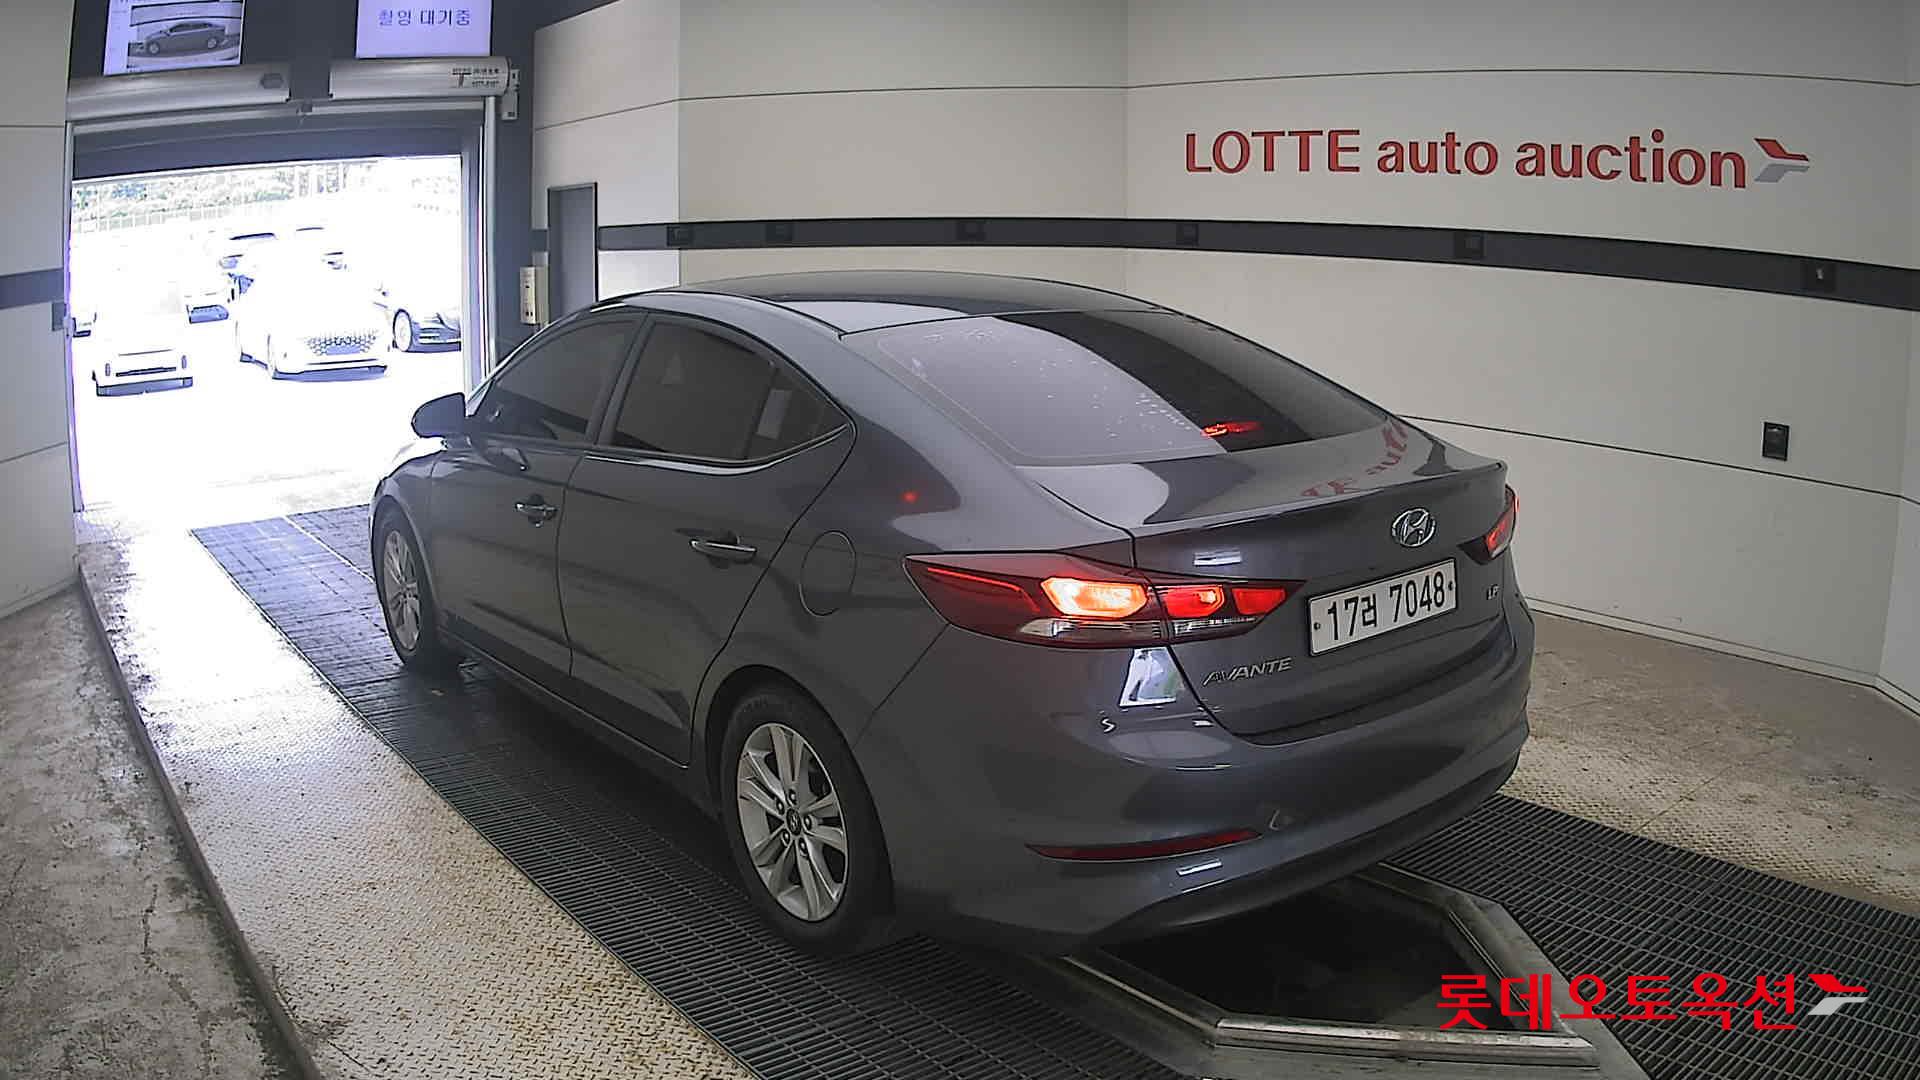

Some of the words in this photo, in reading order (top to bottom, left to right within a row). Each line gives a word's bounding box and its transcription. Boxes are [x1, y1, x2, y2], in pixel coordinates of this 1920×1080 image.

[420, 8, 470, 26] 대기중
[1185, 129, 1360, 174] LOTTE
[1376, 131, 1498, 175] auto
[1514, 129, 1746, 189] auction
[1327, 593, 1378, 641] 17러
[1389, 571, 1445, 623] 7048
[1201, 657, 1293, 686] AVANTE
